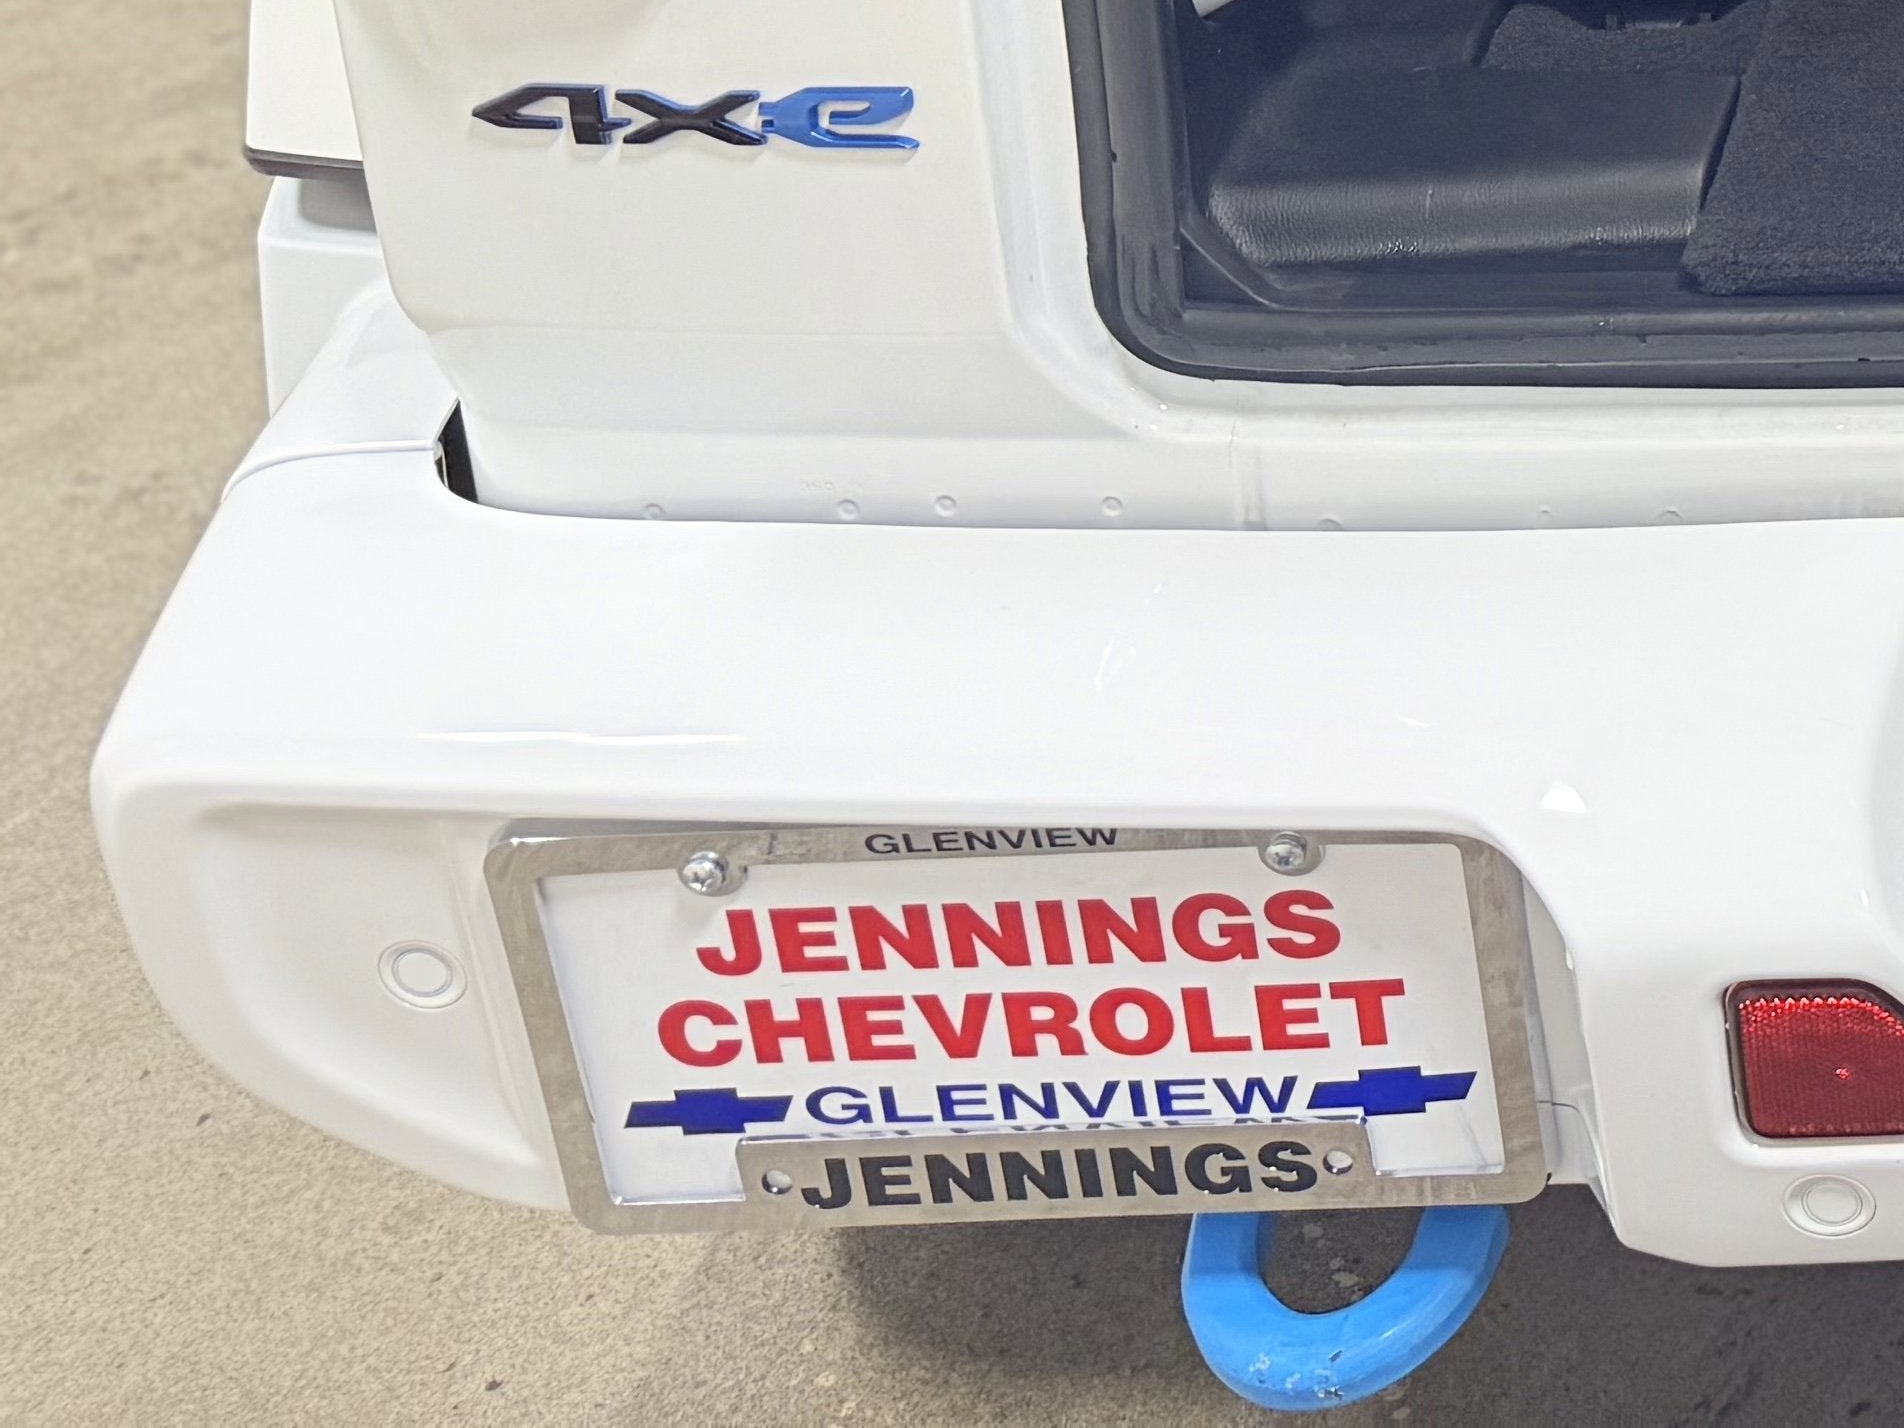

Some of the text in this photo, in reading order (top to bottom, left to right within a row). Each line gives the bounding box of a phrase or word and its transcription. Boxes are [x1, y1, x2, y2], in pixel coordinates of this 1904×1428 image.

[863, 827, 1118, 855] GLENVIEW
[697, 890, 1342, 978] JENNINGS
[657, 978, 1406, 1069] CHEVROLET
[805, 1074, 1297, 1126] GLENVIEW
[800, 1139, 1320, 1211] JENNINGS
